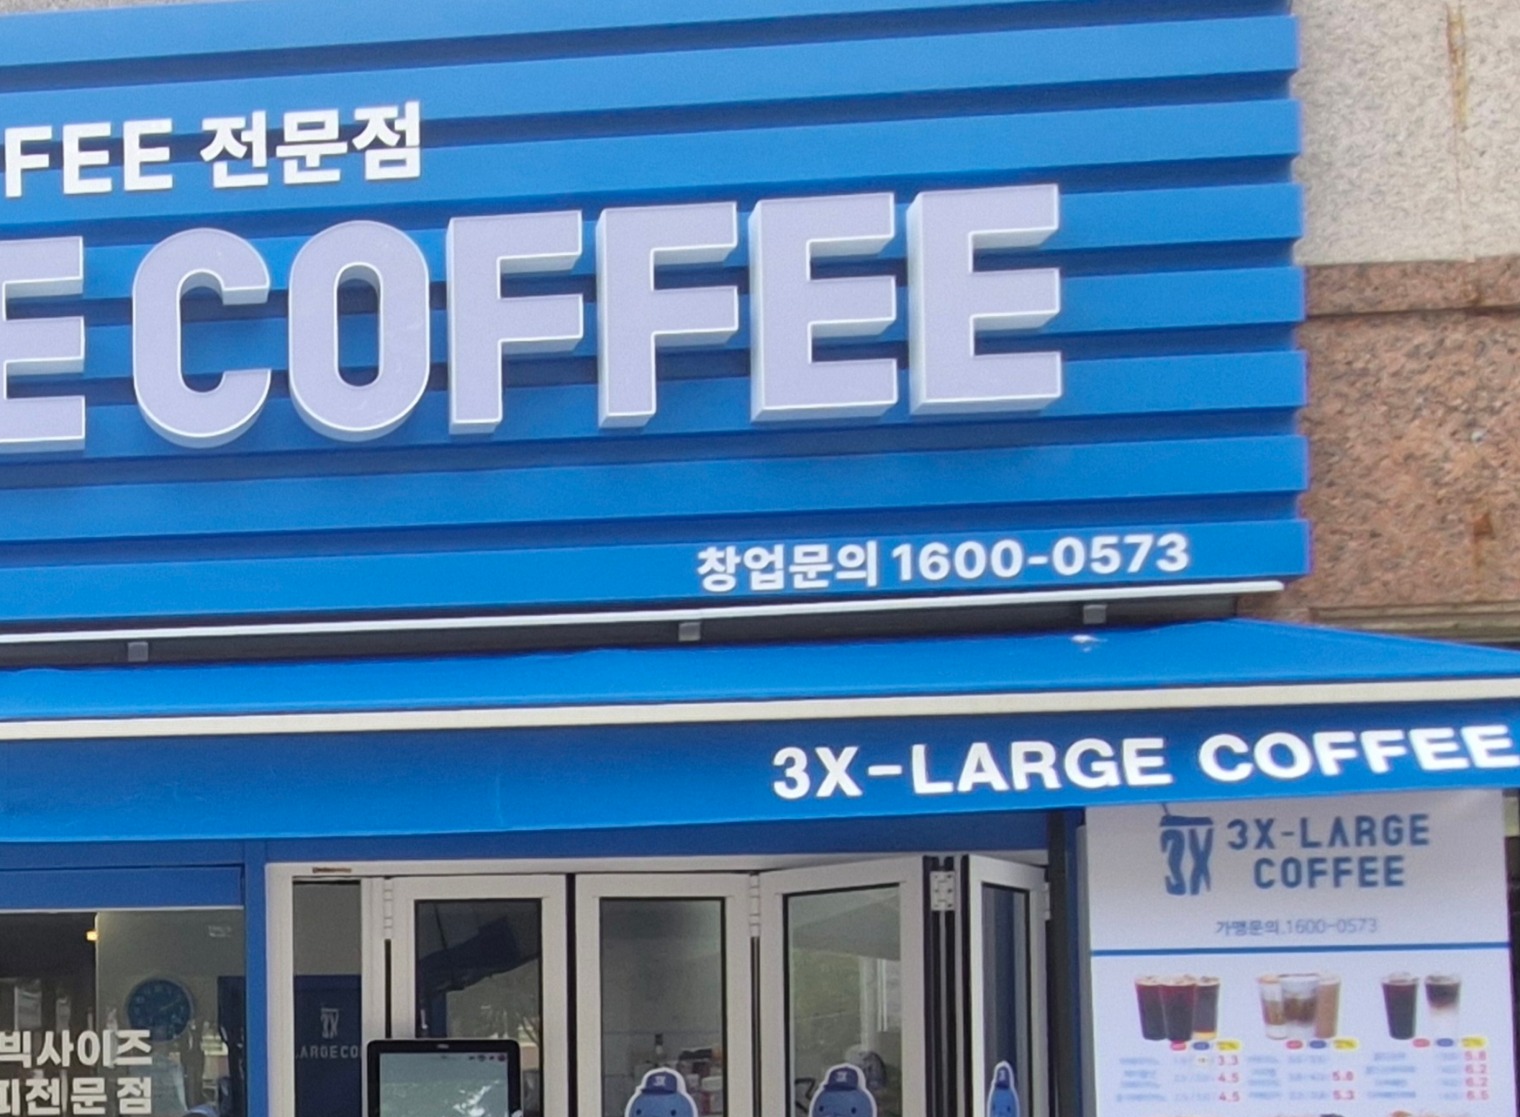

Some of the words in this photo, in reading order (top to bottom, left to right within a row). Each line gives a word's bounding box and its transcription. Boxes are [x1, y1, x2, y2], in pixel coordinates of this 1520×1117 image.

[199, 100, 423, 189] 전문점
[132, 183, 1064, 449] COFFEE
[696, 539, 878, 591] 창업문의
[890, 532, 1189, 583] 1600-0573
[772, 738, 1174, 800] 3X-LARGE
[1199, 724, 1520, 785] COFFEE
[1227, 813, 1429, 850] 3X-LARGE
[1253, 855, 1405, 889] COFFEE
